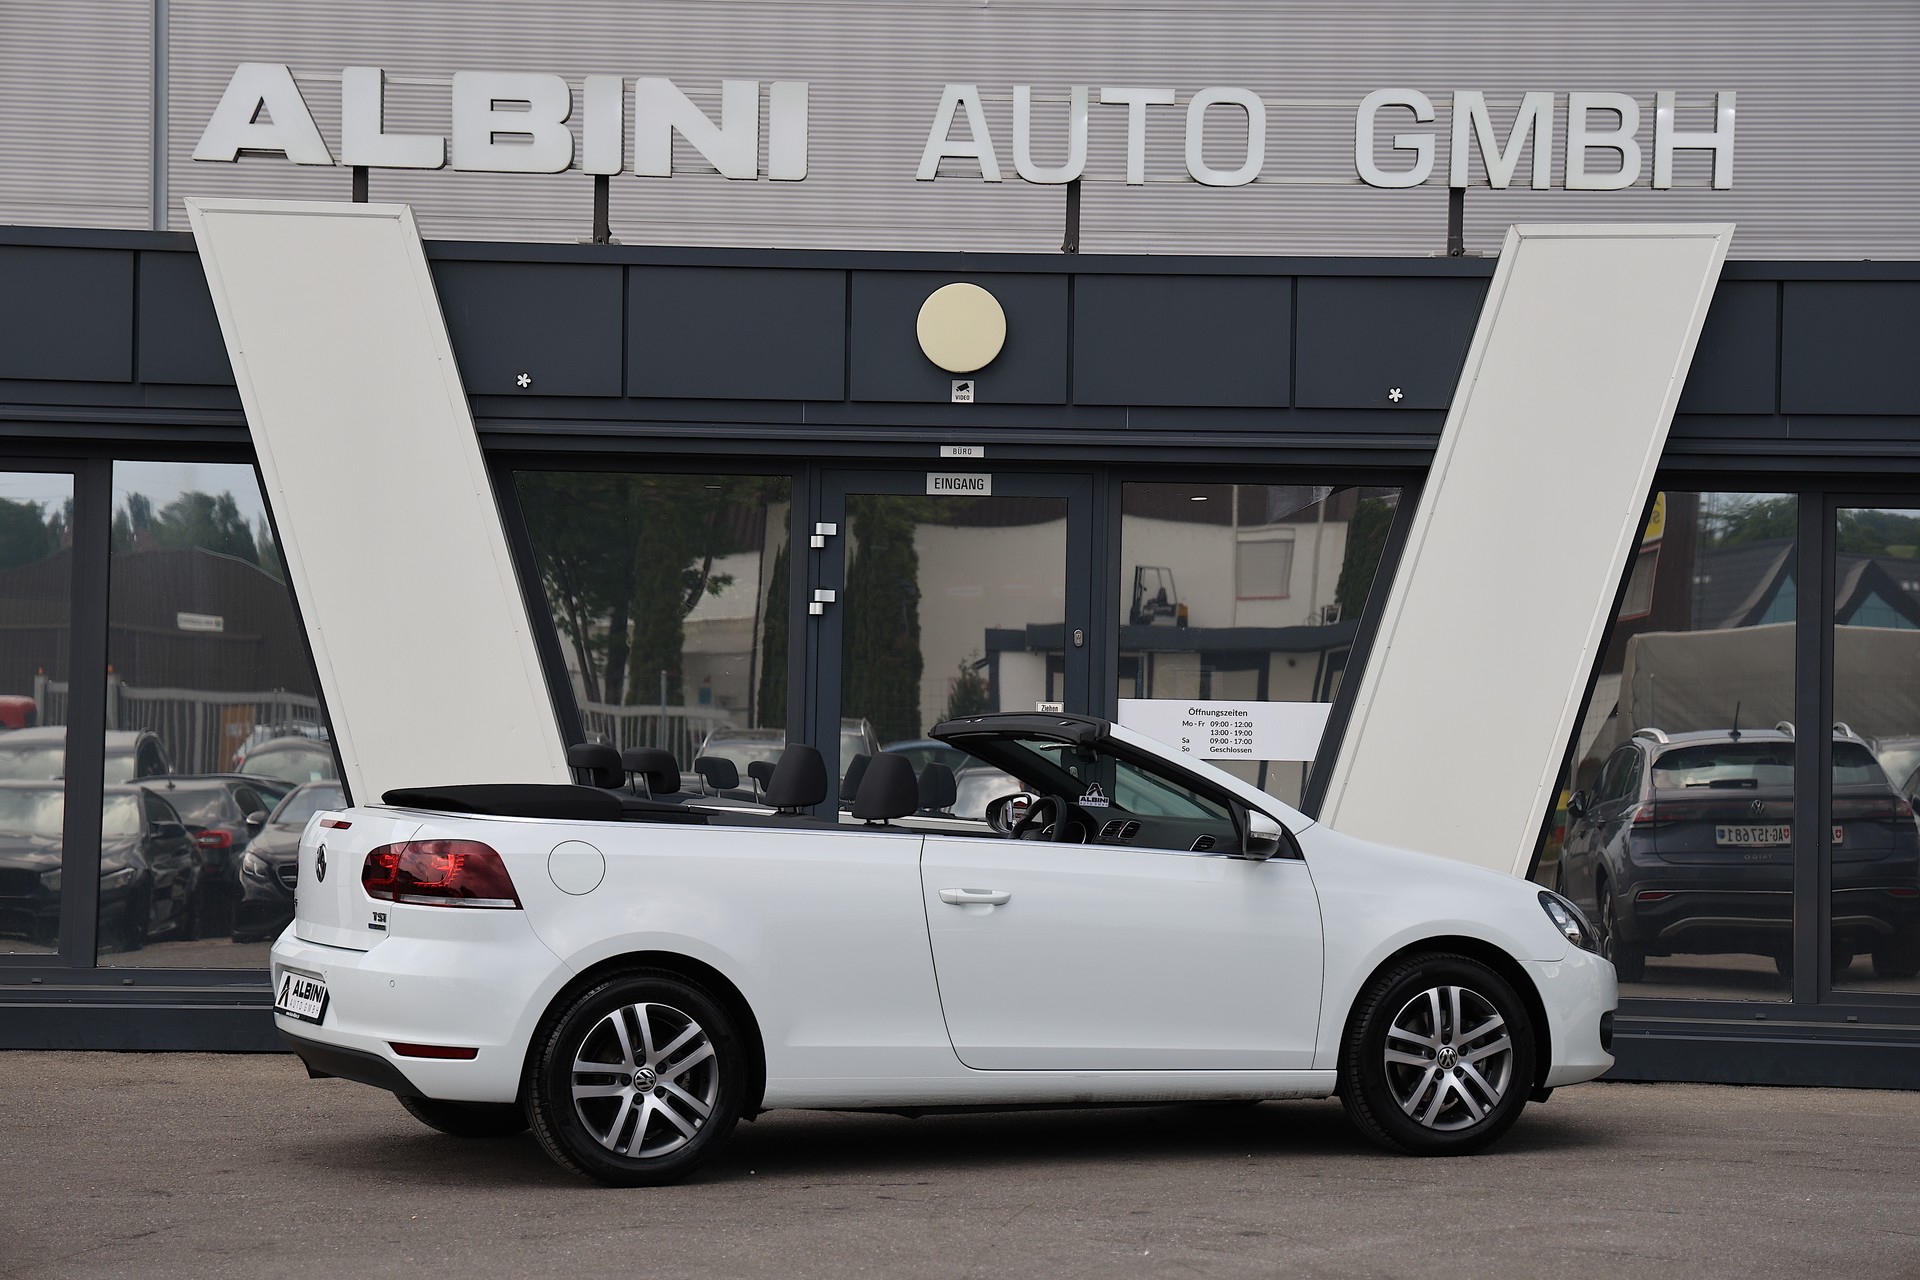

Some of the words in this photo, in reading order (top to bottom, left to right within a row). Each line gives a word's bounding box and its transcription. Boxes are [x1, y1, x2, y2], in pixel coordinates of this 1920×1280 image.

[192, 62, 809, 181] ALBINI
[915, 84, 1267, 187] AUTO
[1354, 87, 1738, 191] GMBH
[952, 446, 972, 455] BÜRO
[934, 477, 984, 490] EINGANG
[1188, 706, 1248, 718] Öffnungszeiten
[1210, 720, 1230, 728] 09:00
[372, 911, 387, 923] TSI
[292, 979, 325, 1004] ALBINI
